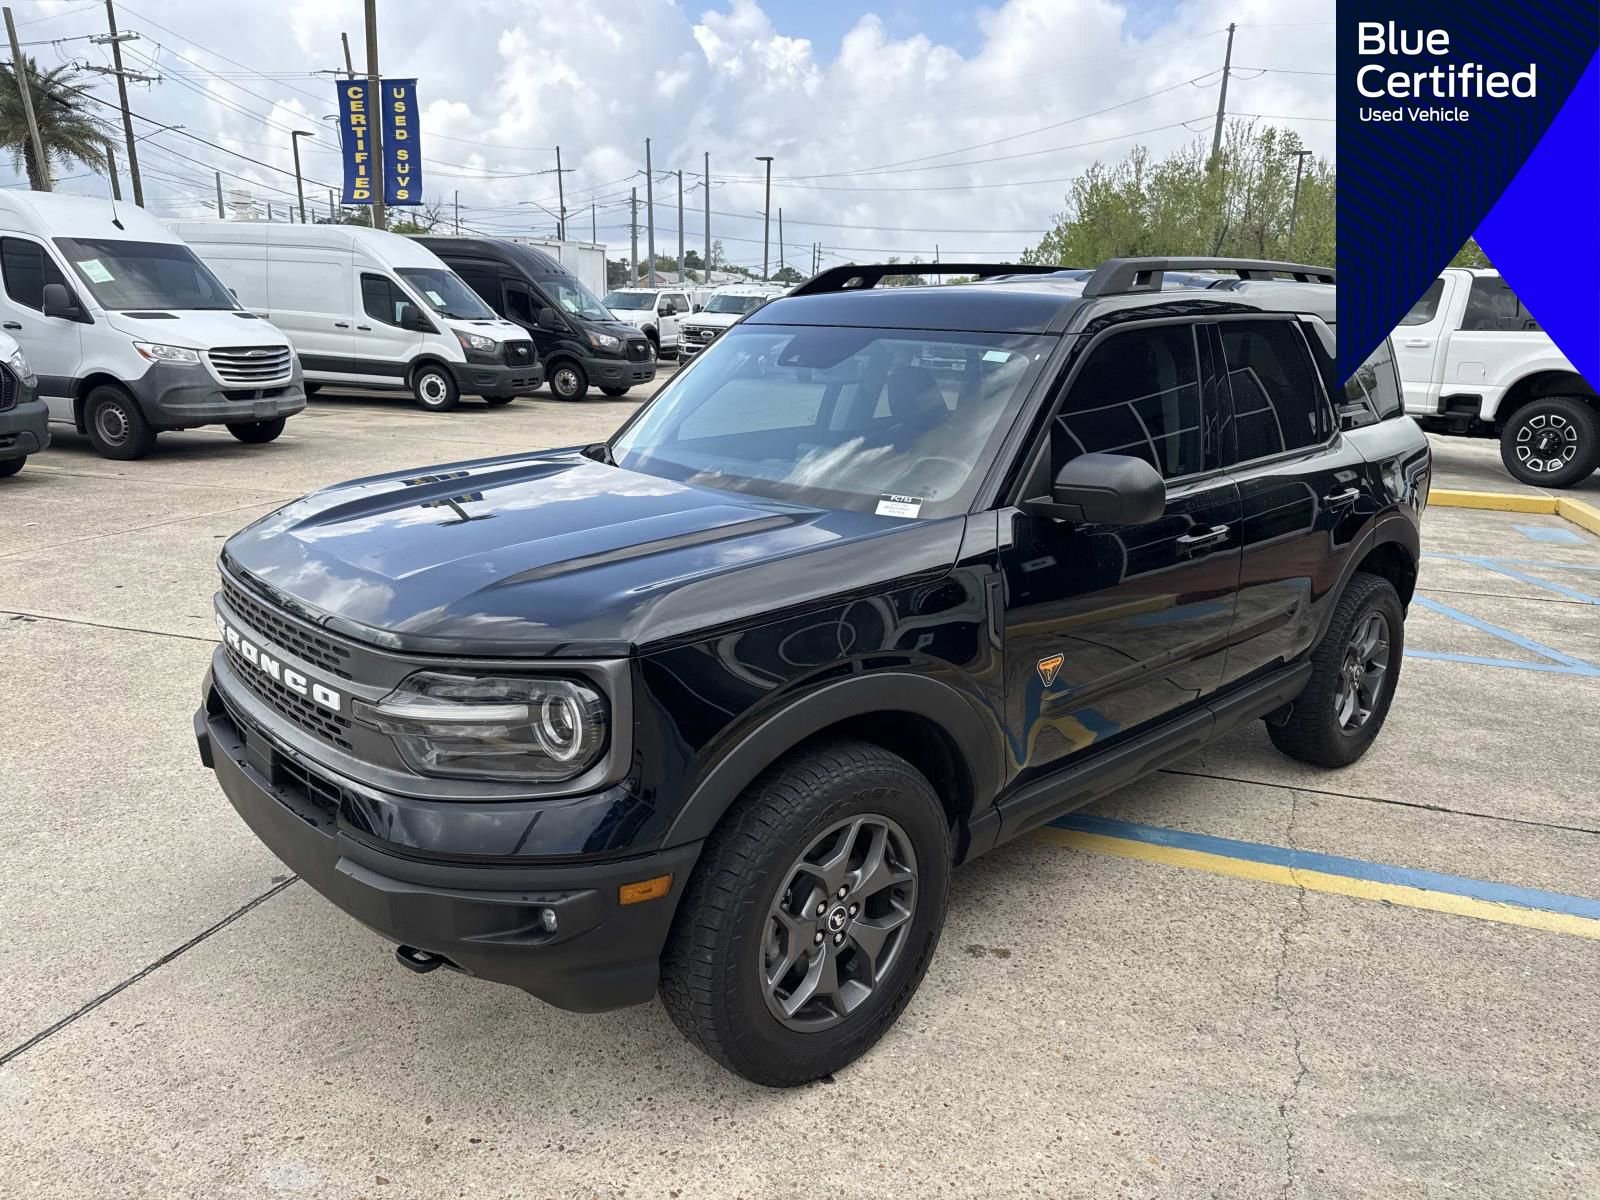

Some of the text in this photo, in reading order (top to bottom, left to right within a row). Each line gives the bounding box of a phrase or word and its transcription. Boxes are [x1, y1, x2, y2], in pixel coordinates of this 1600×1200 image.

[347, 86, 370, 200] CERTIFIED
[393, 87, 411, 200] USED SUVS
[216, 612, 340, 711] BRONCO
